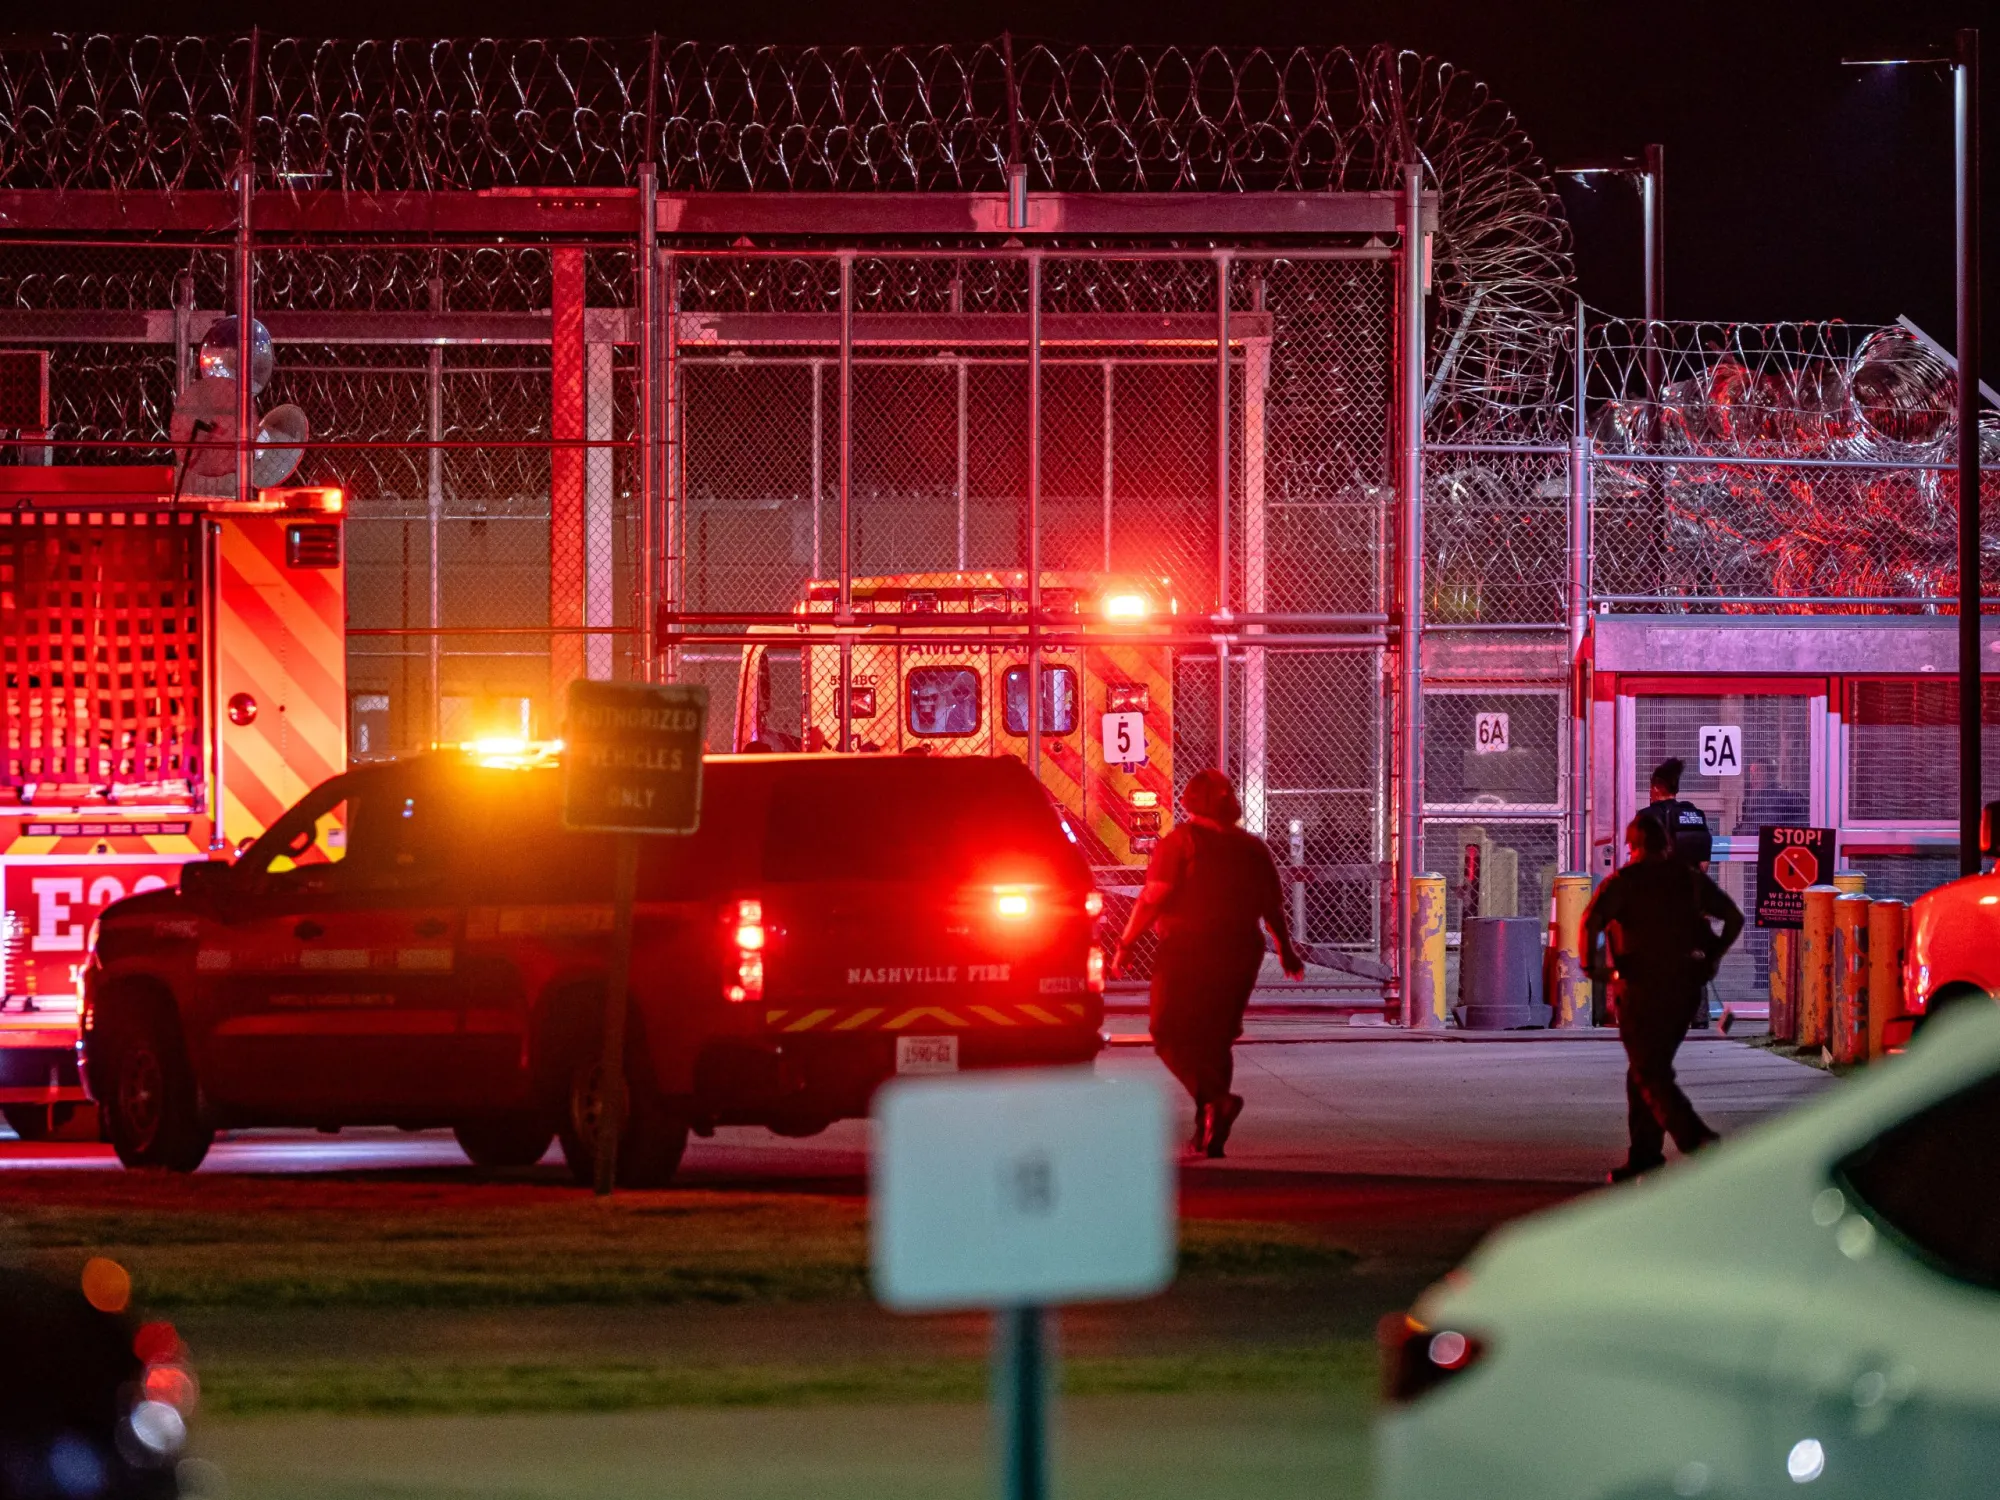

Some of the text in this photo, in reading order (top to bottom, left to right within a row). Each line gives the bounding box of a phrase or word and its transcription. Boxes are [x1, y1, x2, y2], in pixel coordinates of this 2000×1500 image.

[1117, 721, 1131, 753] 5
[1479, 719, 1505, 744] 6A
[1704, 735, 1737, 767] 5A
[1773, 828, 1822, 846] STOP!
[1763, 900, 1802, 908] PROHIB
[848, 965, 1011, 984] NASHVILLE FIRE
